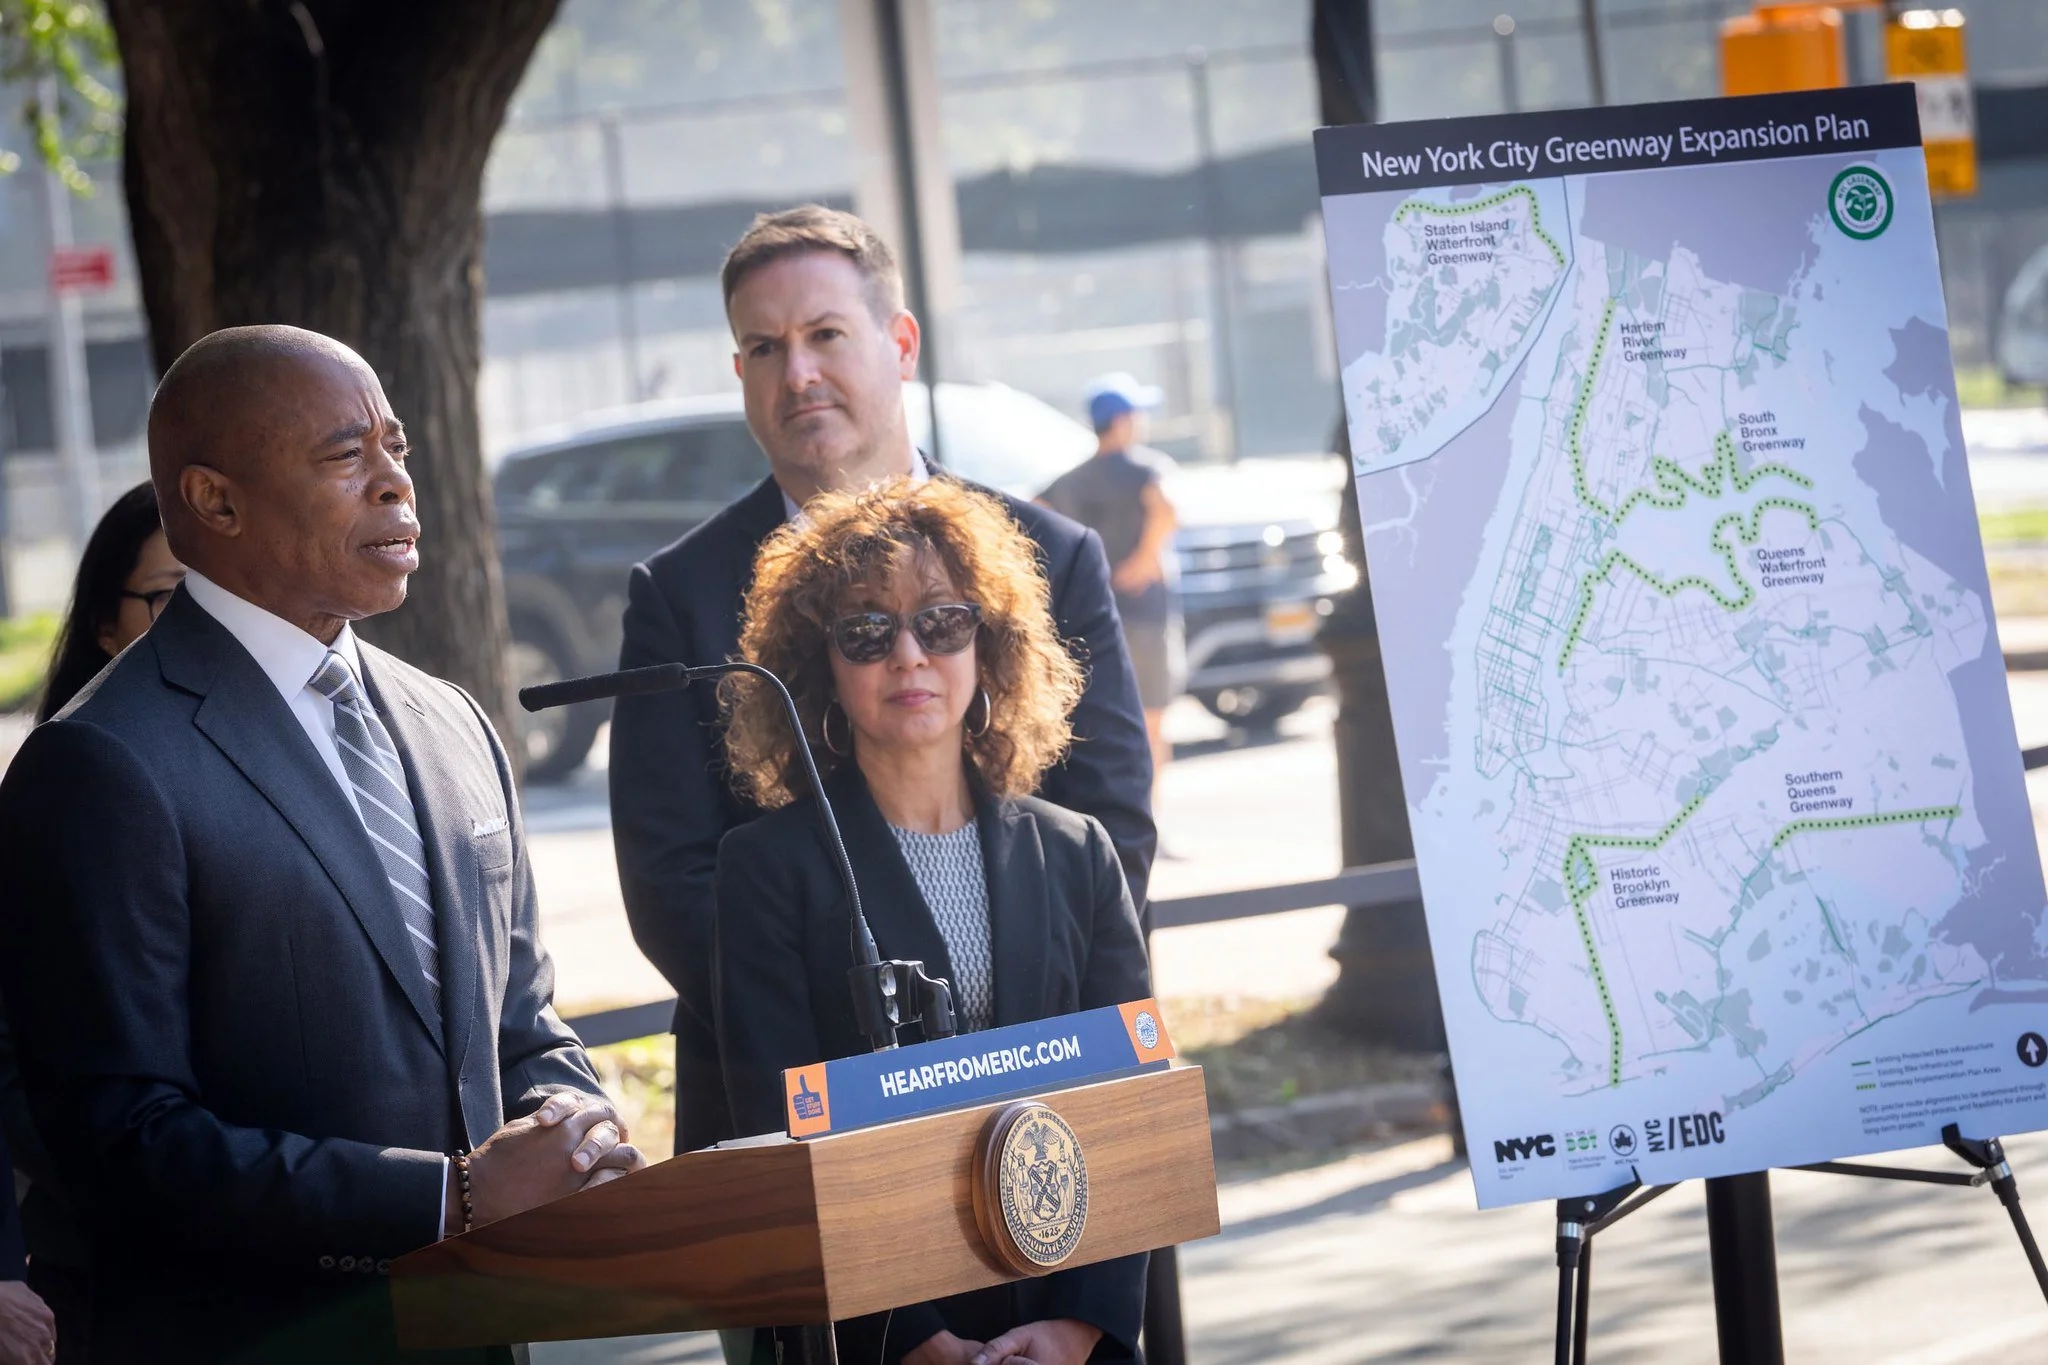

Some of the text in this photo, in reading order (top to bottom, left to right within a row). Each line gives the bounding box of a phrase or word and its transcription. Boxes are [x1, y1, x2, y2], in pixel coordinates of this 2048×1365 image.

[1361, 113, 1870, 179] New York City Greenway Expansion Plan
[1424, 219, 1509, 237] Staten Island
[1426, 235, 1496, 251] Waterfront
[1427, 251, 1493, 265] Greenway
[1620, 321, 1666, 334] Harlem
[1622, 336, 1655, 348] River
[1624, 348, 1687, 362] Greenway
[1738, 411, 1776, 425] South
[1741, 427, 1778, 438] Bronx
[1743, 437, 1805, 453] Greenway
[1757, 547, 1805, 560] Queens
[1759, 558, 1826, 574] Waterfront
[1762, 572, 1824, 588] Greenway
[1785, 771, 1843, 786] Southern
[1787, 785, 1836, 799] Queens
[1790, 797, 1853, 813] Greenway
[1610, 865, 1661, 880] Historic
[1613, 879, 1671, 895] Brooklyn
[1615, 892, 1680, 909] Greenway
[880, 1035, 1081, 1098] HEARFROMERIC.COM
[1645, 1120, 1665, 1152] NYC
[1494, 1134, 1556, 1163] NYC
[1041, 1227, 1059, 1239] 1625
[1024, 1234, 1063, 1254] CIVITATIS
